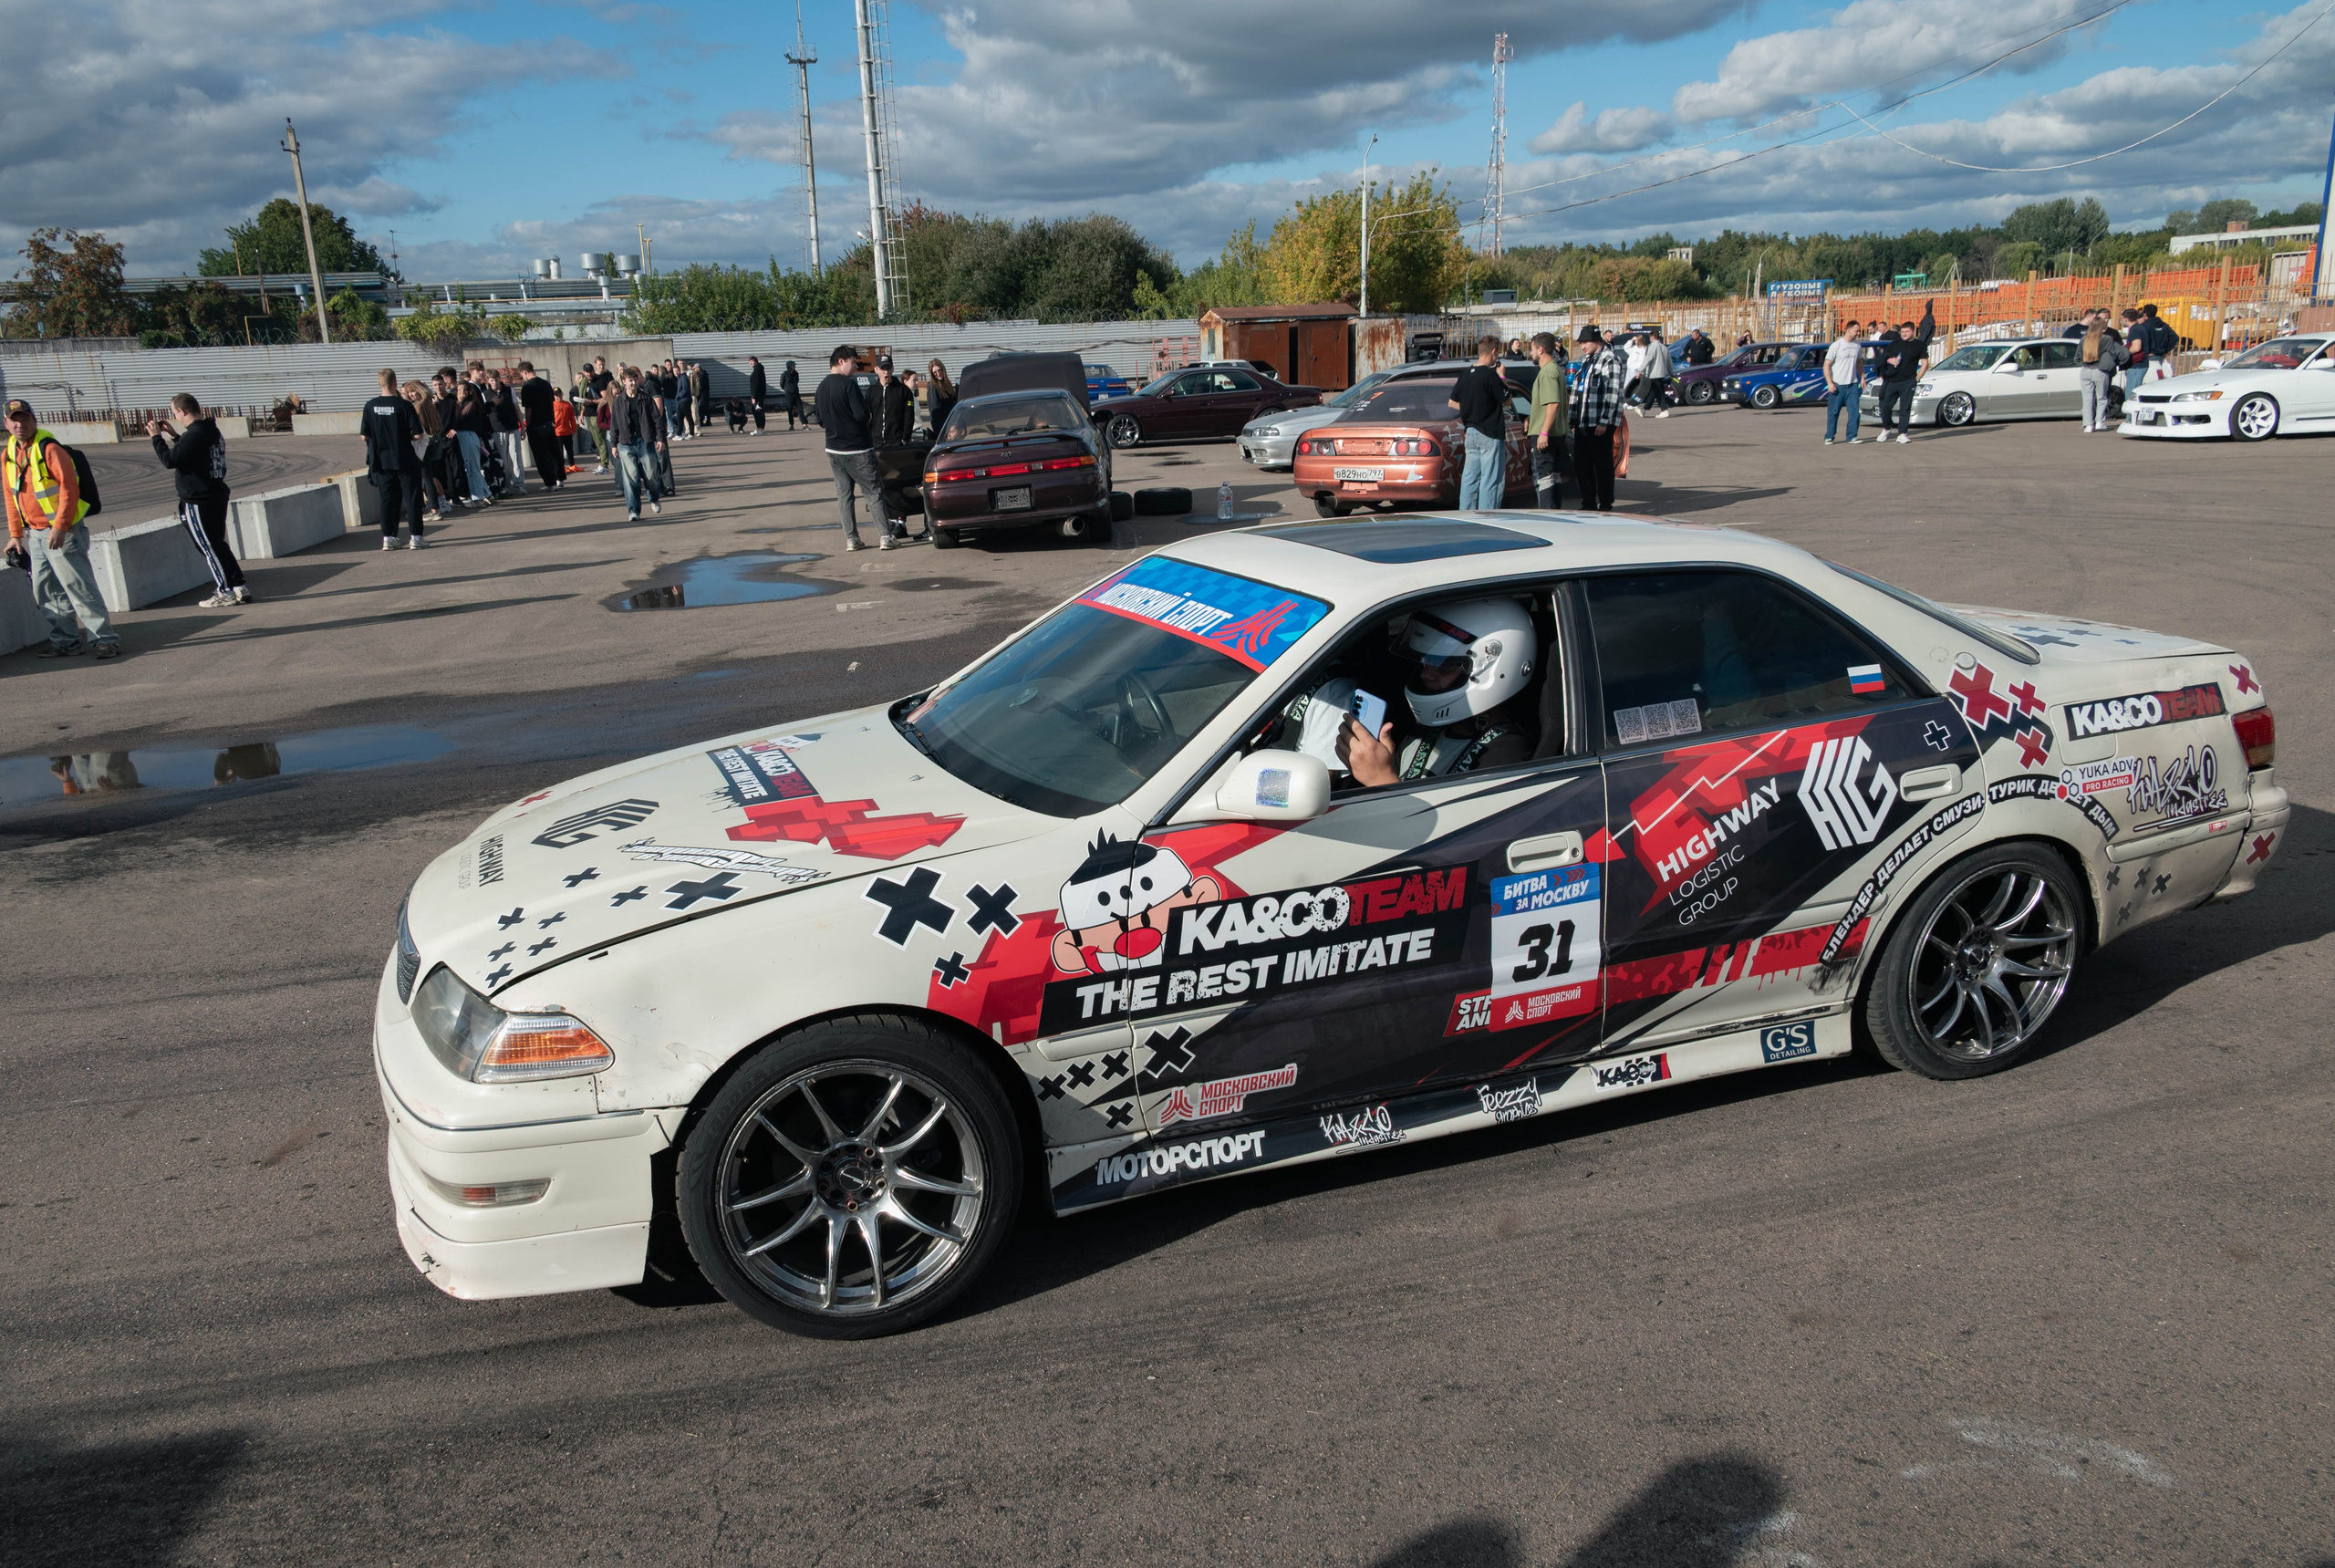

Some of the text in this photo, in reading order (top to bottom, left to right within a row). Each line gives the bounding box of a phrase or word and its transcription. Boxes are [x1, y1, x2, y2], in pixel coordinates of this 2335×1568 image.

[1770, 289, 1821, 297] ЛГКОВЫЕ
[1160, 600, 1234, 636] СПОРТ
[2079, 763, 2110, 779] YUKA
[2085, 776, 2130, 791] PRO RACING
[1656, 778, 1780, 882] HIGHWAY
[479, 834, 503, 887] HIGHWAY
[1669, 845, 1744, 906] LOGISTIC
[1503, 874, 1548, 901] БИТВА
[1515, 879, 1590, 911] ЗА МОСКВУ
[1822, 881, 1875, 962] БЛЕНДЕР
[1876, 825, 1931, 888] ДЕЛАЕТ
[2088, 804, 2116, 837] ДЫМ
[1678, 877, 1738, 926] GROUP
[1511, 919, 1575, 982] 31
[1076, 928, 1436, 1019] THE REST IMITATE
[1527, 1004, 1552, 1020] СПОРТ
[1528, 986, 1582, 1009] МОСКОВСКИЙ
[1767, 1024, 1808, 1052] G'S
[1769, 1045, 1811, 1060] DETAILING
[1200, 1066, 1295, 1099] МОСКОВСКИЙ
[1199, 1093, 1244, 1116] СПОРТ
[1096, 1130, 1266, 1185] МОТОРСПОРТ
